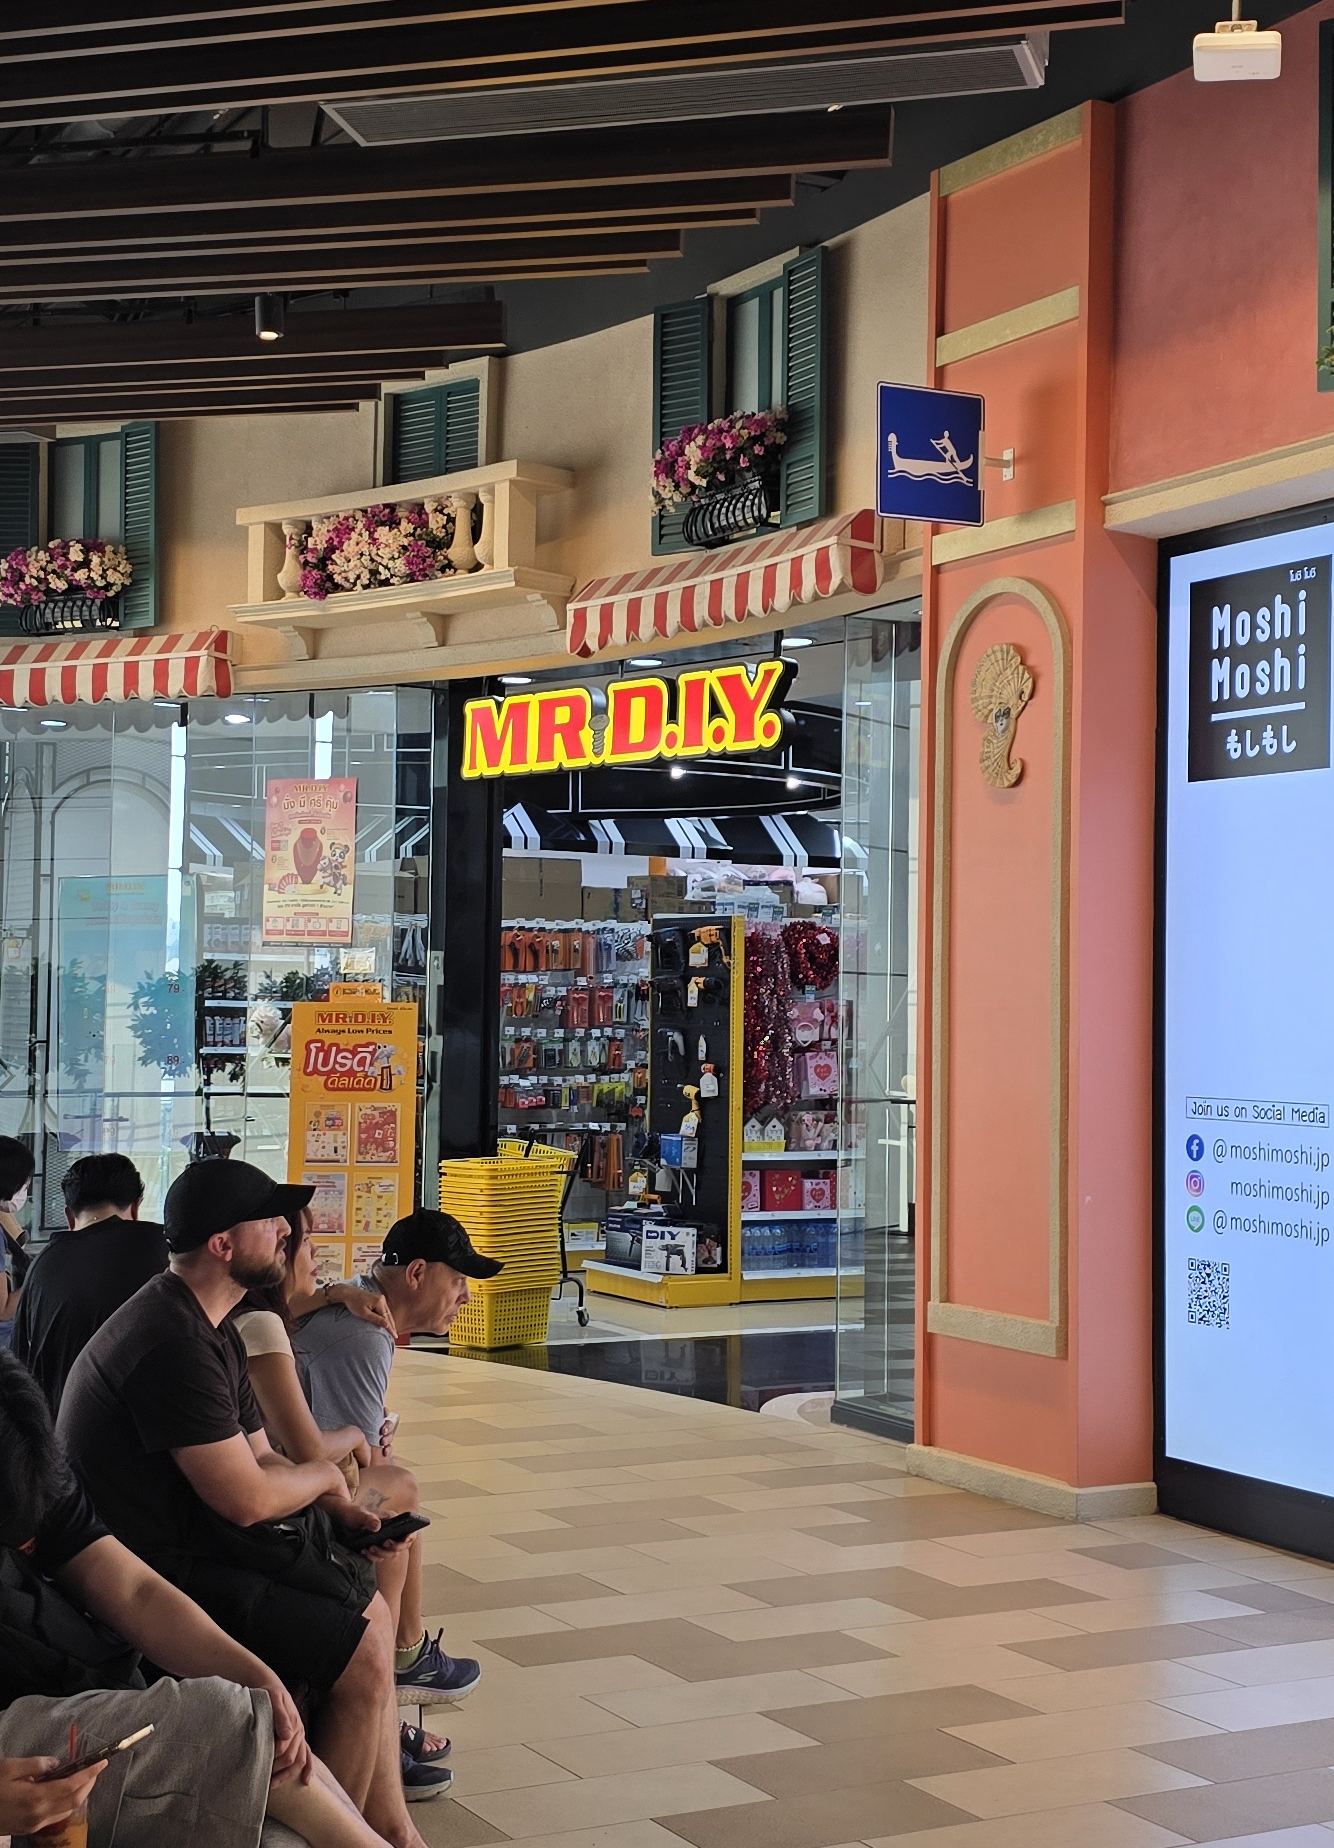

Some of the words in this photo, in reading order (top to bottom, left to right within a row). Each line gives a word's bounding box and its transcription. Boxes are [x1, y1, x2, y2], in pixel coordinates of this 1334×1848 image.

[1212, 590, 1306, 650] Moshi
[1211, 643, 1306, 702] Moshi
[1226, 724, 1297, 760] もしもし
[315, 1027, 346, 1035] Always
[347, 1027, 364, 1035] Low
[366, 1027, 393, 1035] Prices
[307, 1043, 376, 1073] โปรดี
[327, 1073, 376, 1089] ดีลเด็ด
[1191, 1101, 1212, 1116] Join
[1217, 1105, 1229, 1117] us
[1234, 1106, 1247, 1118] on
[1252, 1104, 1285, 1121] Social
[1292, 1106, 1325, 1123] Media
[1213, 1138, 1330, 1172] @moshimoshi.jp
[1230, 1178, 1330, 1210] moshimoshi.jp
[646, 1229, 681, 1241] DIY
[1213, 1209, 1330, 1247] @moshimoshi.jp
